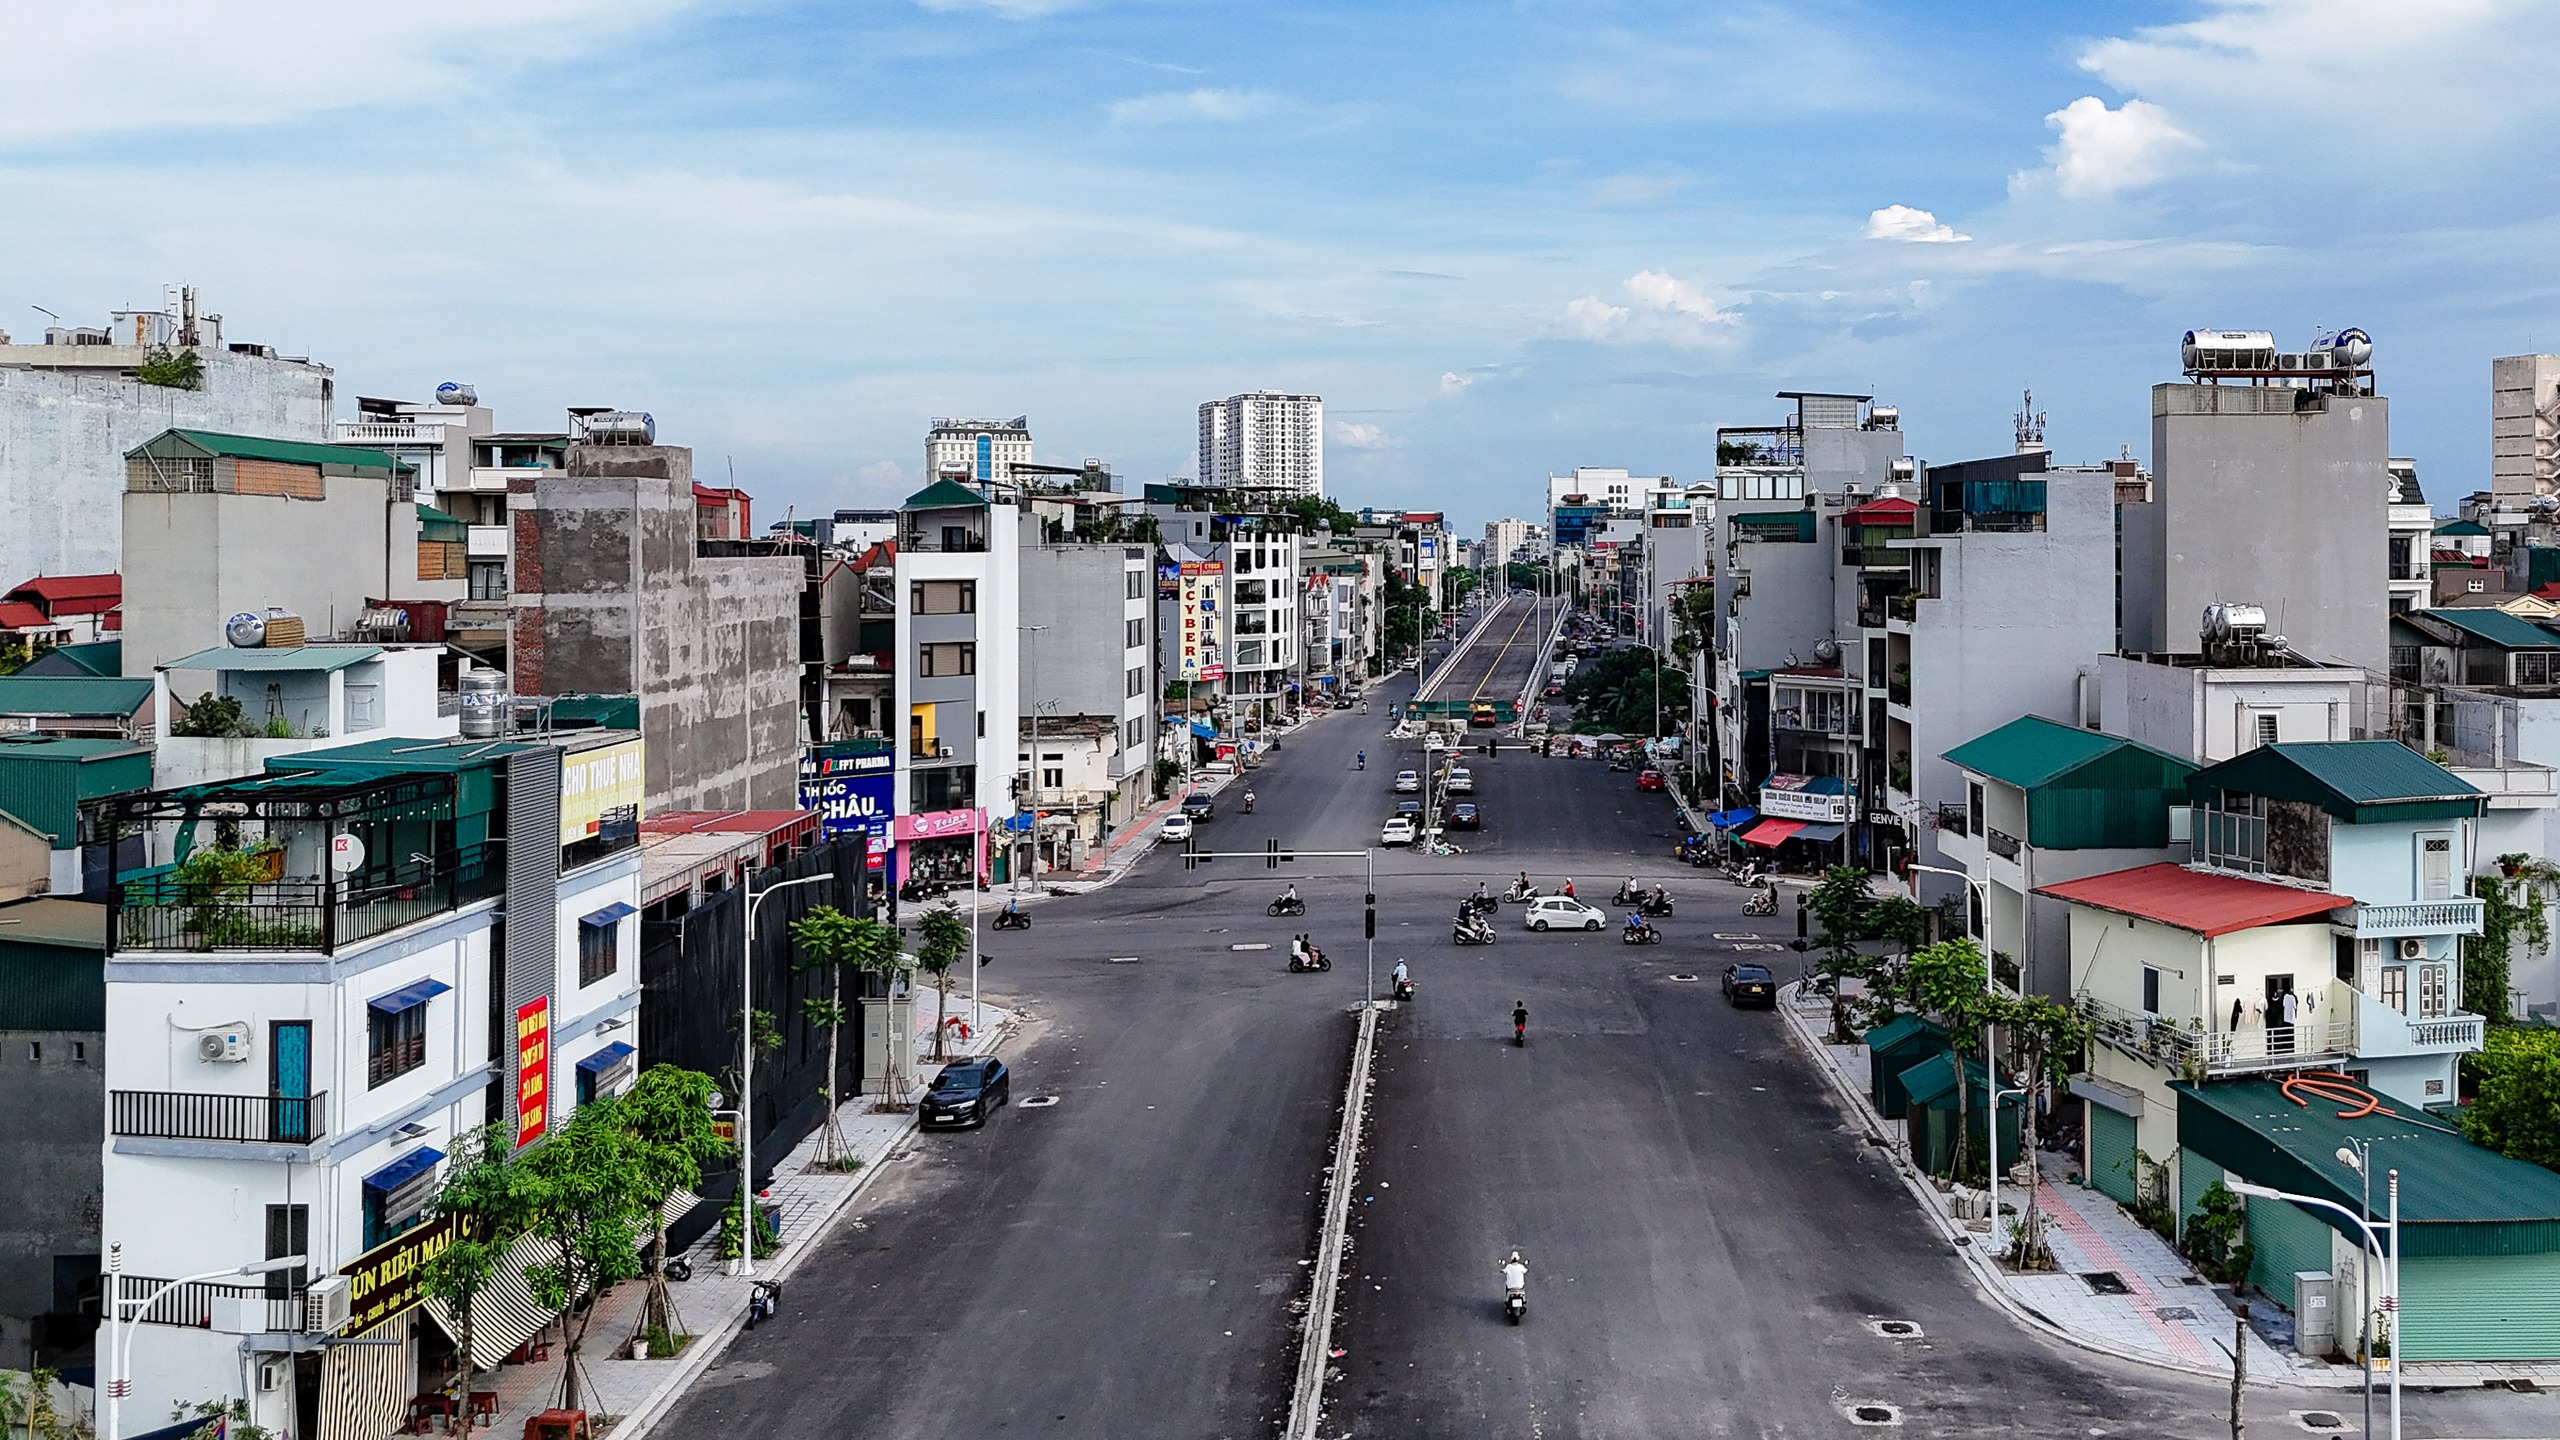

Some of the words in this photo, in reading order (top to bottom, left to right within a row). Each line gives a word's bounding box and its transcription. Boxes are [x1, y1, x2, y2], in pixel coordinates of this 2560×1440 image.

[1184, 590, 1196, 656] CYBER
[563, 763, 586, 796] CHO
[589, 750, 617, 791] THUÊ
[619, 744, 641, 783] NHÀ
[839, 759, 855, 771] FPT
[855, 756, 890, 770] PHARMA
[813, 793, 875, 820] CHÂU
[350, 1266, 378, 1300] ÚN
[380, 1245, 419, 1287] RIÊU
